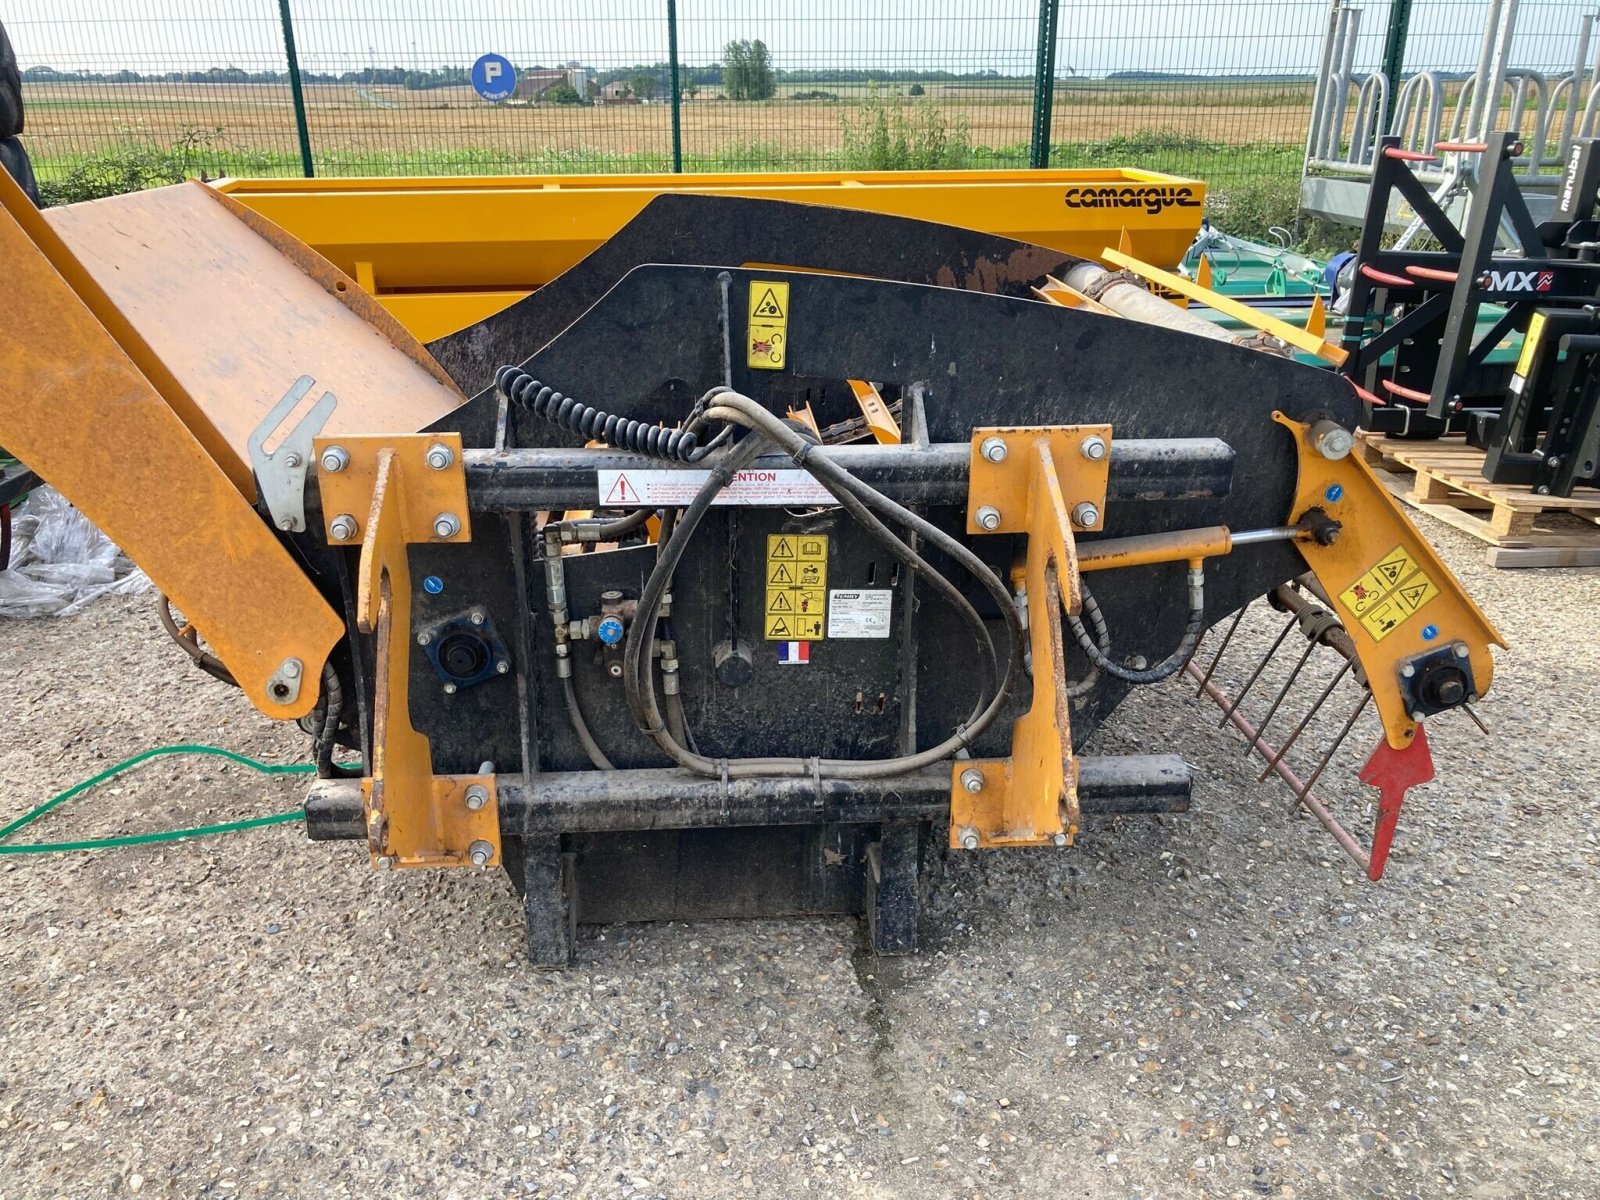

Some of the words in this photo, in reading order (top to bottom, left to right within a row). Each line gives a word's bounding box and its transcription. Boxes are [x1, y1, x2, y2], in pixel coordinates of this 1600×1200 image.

[484, 61, 502, 84] P
[482, 89, 509, 100] PARKING
[1560, 144, 1582, 212] manubal
[1065, 187, 1201, 215] camargue
[1487, 271, 1539, 292] MX
[732, 472, 776, 482] ENTION
